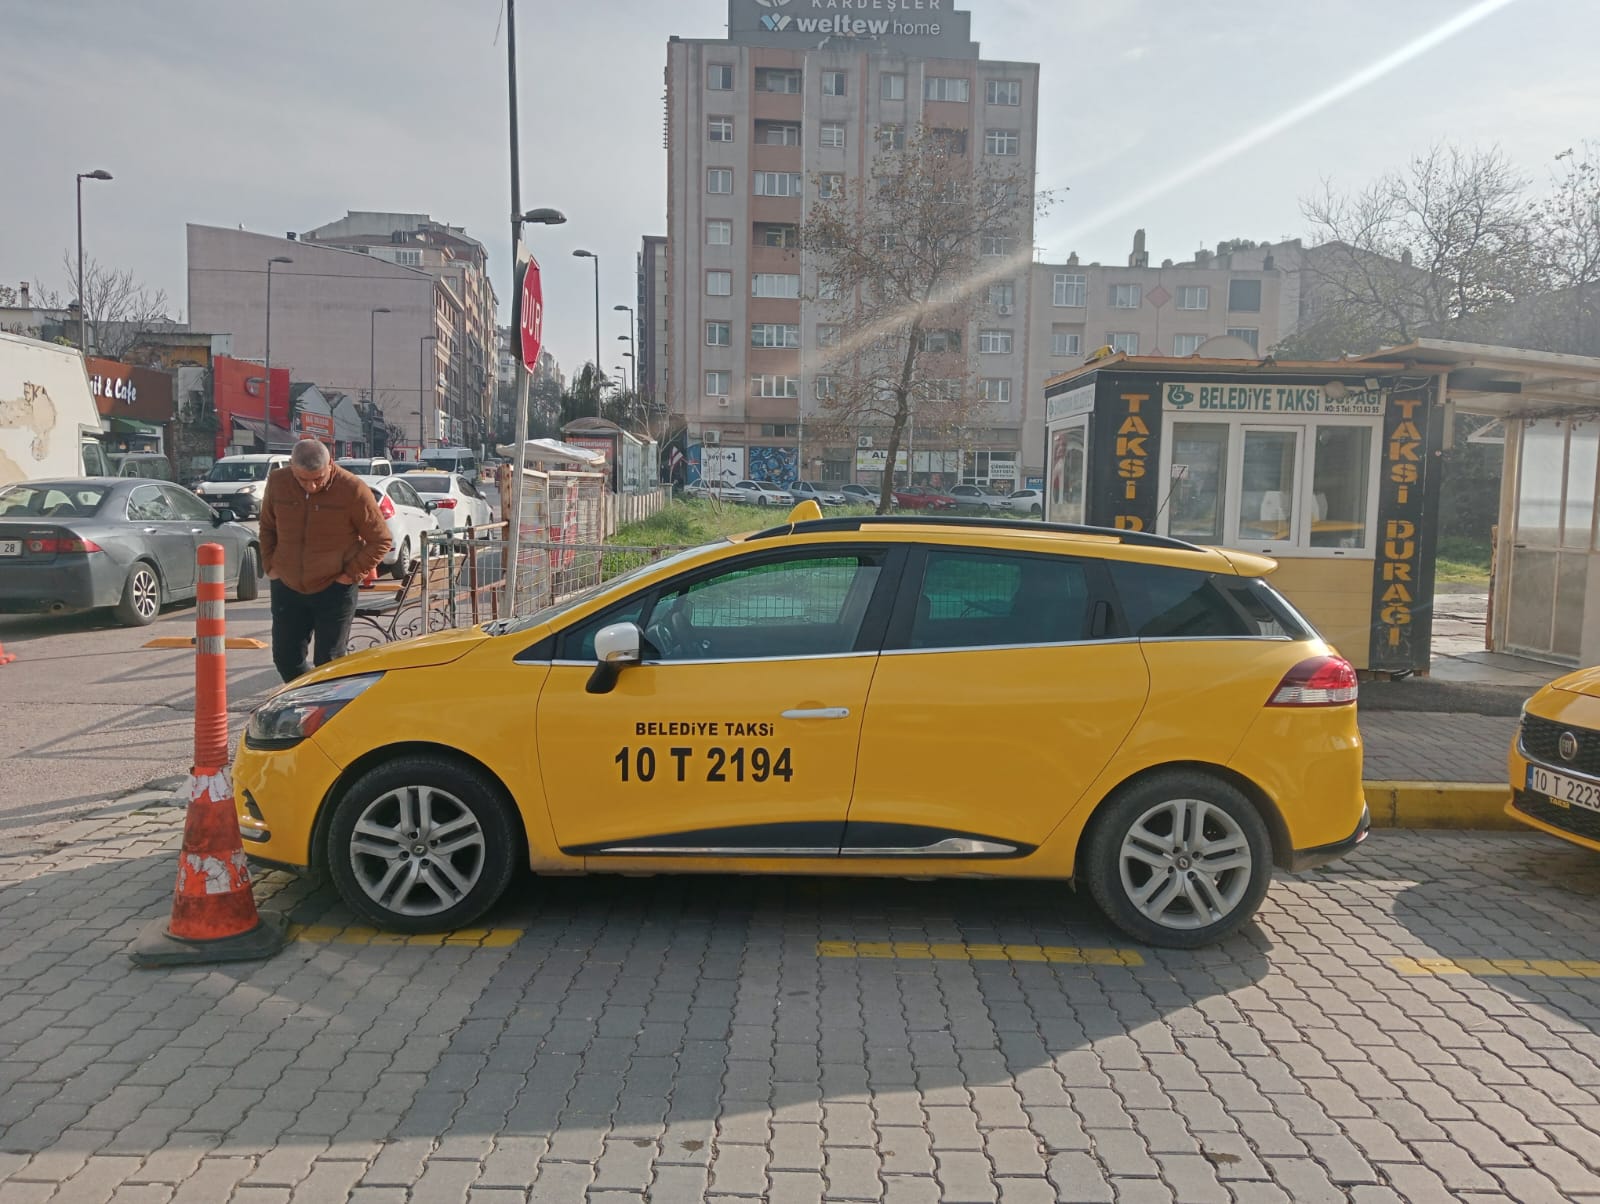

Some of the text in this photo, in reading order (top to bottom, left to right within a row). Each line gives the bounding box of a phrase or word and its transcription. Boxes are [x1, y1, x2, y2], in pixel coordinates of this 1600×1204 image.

[812, 0, 941, 11] KARDEŞLER
[797, 14, 941, 35] weltew home
[523, 287, 541, 344] DUR
[114, 377, 137, 405] Cafe
[1199, 387, 1271, 411] BELEDiYE
[1277, 389, 1320, 412] TAKSi
[4, 543, 15, 553] 28
[1380, 520, 1415, 646] DURAĞI
[635, 722, 774, 737] BELEDiYE TAKSi
[615, 746, 793, 782] 10 T 2194
[1535, 769, 1547, 791] 10
[1553, 776, 1561, 796] T
[1566, 780, 1600, 809] 2223
